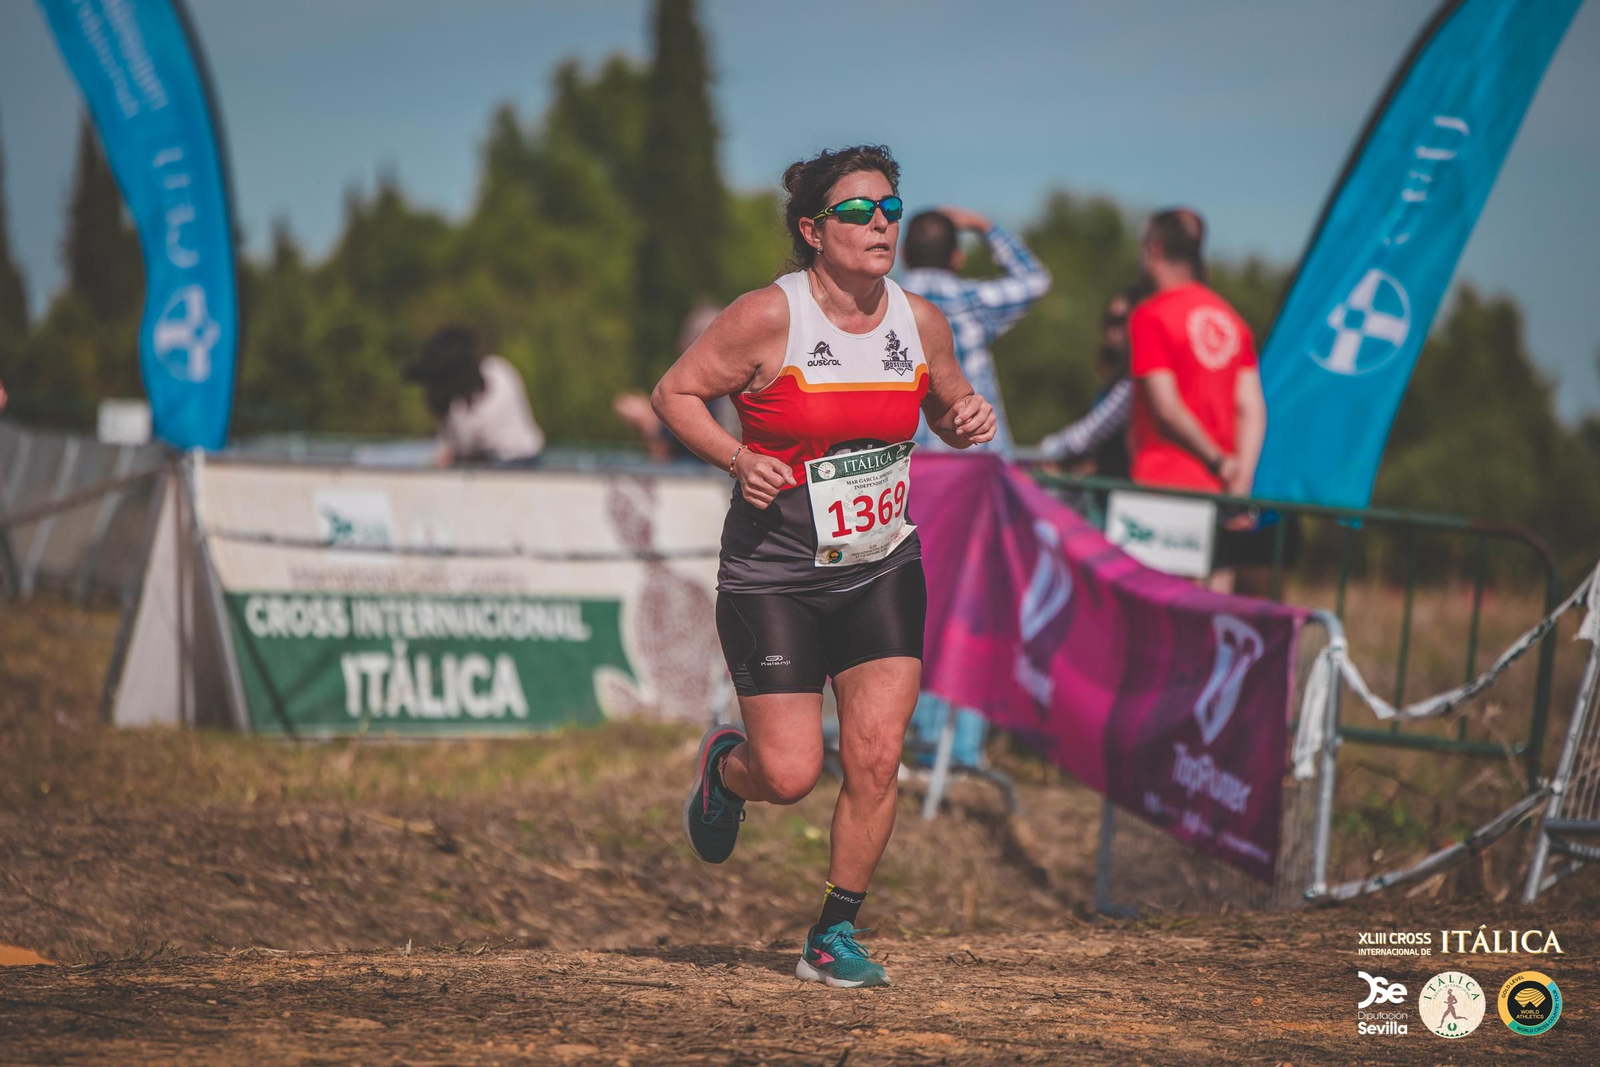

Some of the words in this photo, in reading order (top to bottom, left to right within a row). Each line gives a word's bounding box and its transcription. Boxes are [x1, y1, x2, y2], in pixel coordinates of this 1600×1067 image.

[843, 451, 892, 473] ITÁLICA
[858, 475, 879, 484] GARCÍA
[827, 480, 906, 538] 1369
[245, 596, 350, 639] CROSS
[351, 598, 592, 642] INTERNACIONAL
[341, 640, 530, 719] ITÁLICA
